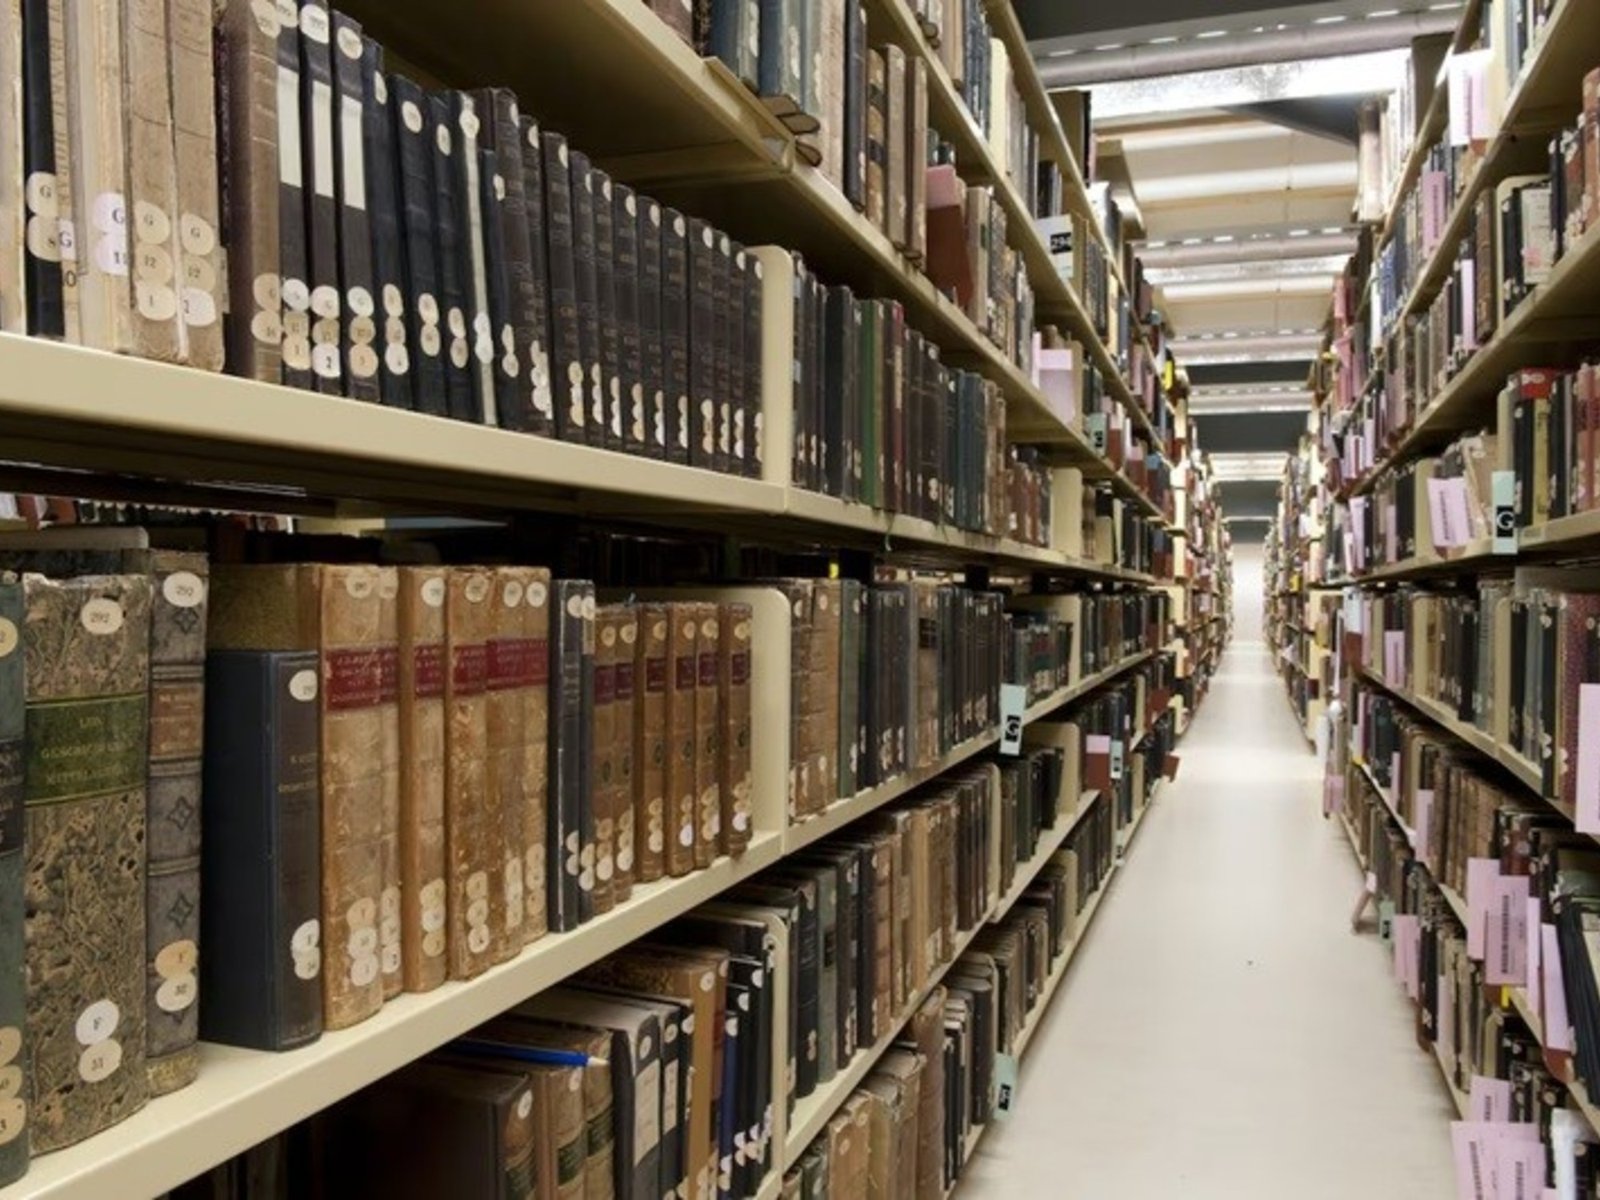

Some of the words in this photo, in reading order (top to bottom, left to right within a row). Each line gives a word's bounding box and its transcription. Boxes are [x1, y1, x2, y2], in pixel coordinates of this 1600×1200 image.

[39, 186, 52, 199] G
[112, 208, 124, 223] G
[143, 215, 154, 226] G
[190, 226, 200, 239] G
[58, 231, 72, 248] G
[1497, 511, 1515, 531] G
[89, 611, 110, 624] 292
